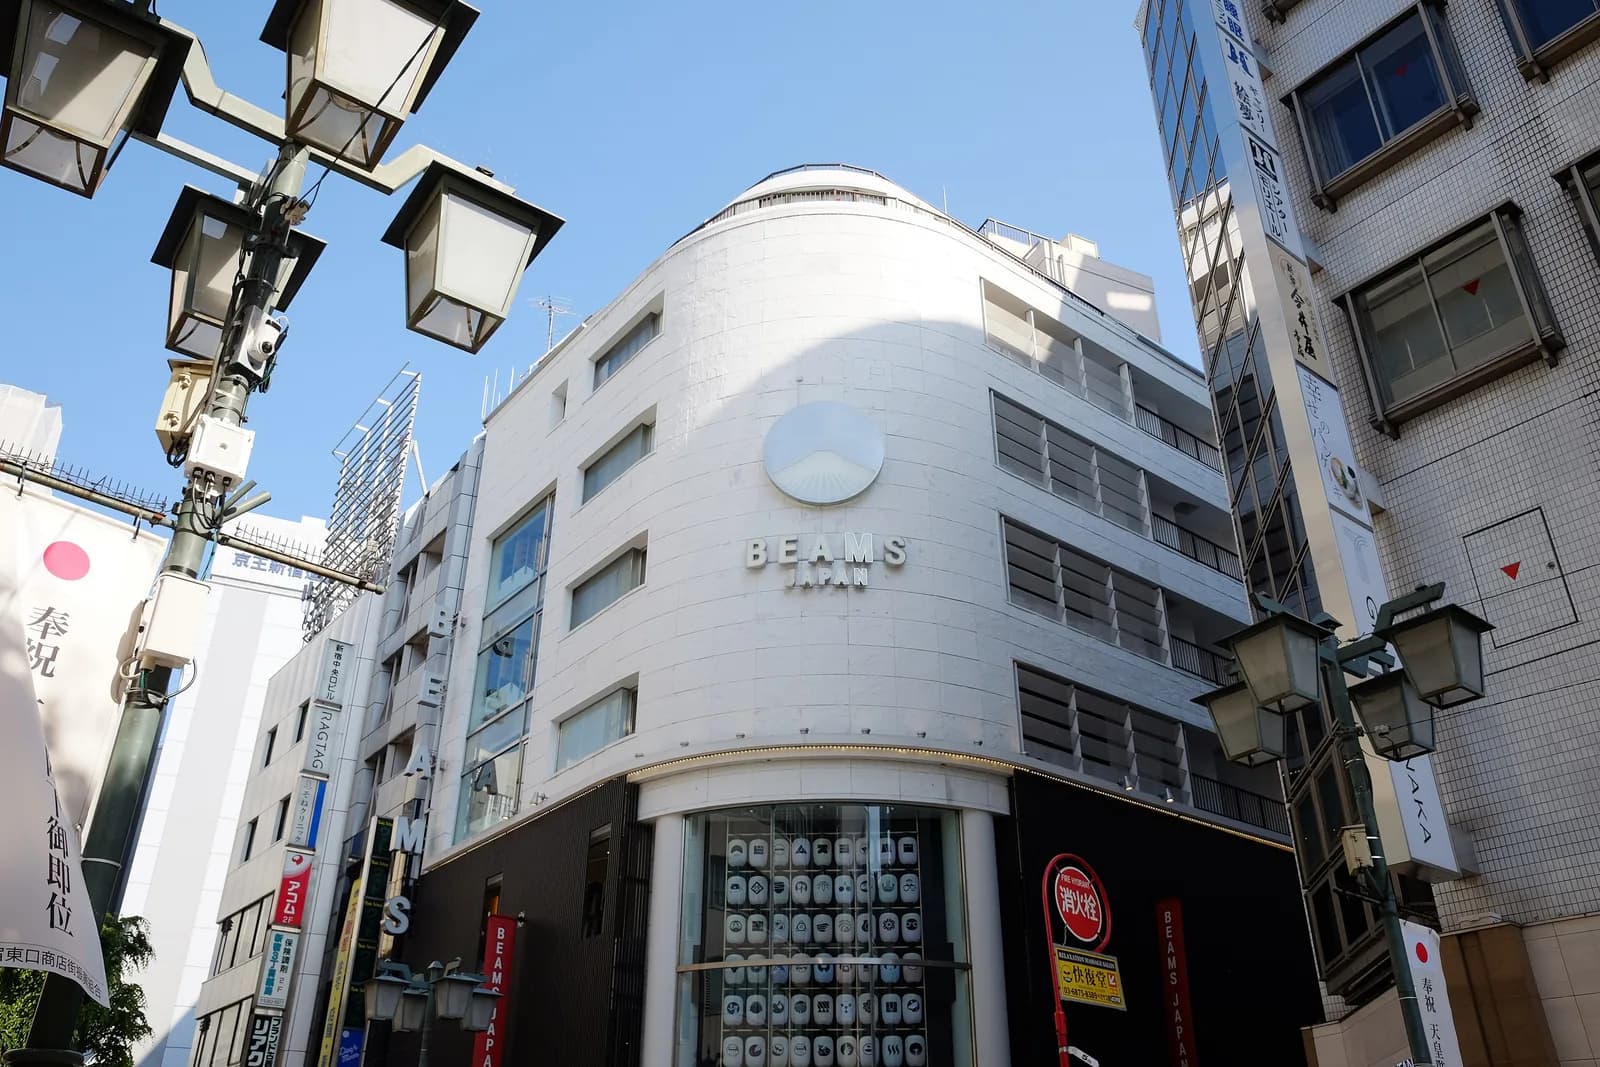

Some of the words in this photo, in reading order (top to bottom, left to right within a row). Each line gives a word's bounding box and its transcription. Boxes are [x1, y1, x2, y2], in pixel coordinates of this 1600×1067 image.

[1258, 173, 1281, 238] モリエール
[1271, 182, 1288, 233] シアター
[746, 532, 907, 568] BEAMS
[785, 561, 869, 588] JAPAN
[27, 606, 70, 678] 奉祝
[325, 643, 344, 701] 新宿中央口ビル
[312, 710, 333, 770] RAGTAG
[382, 604, 451, 936] BEAMS
[282, 879, 301, 916] アコム
[1060, 874, 1071, 884] FIRE
[282, 915, 295, 924] 2F
[1059, 885, 1099, 922] 消火栓
[1164, 911, 1178, 985] BEAMS
[1421, 977, 1437, 1014] 奉祝
